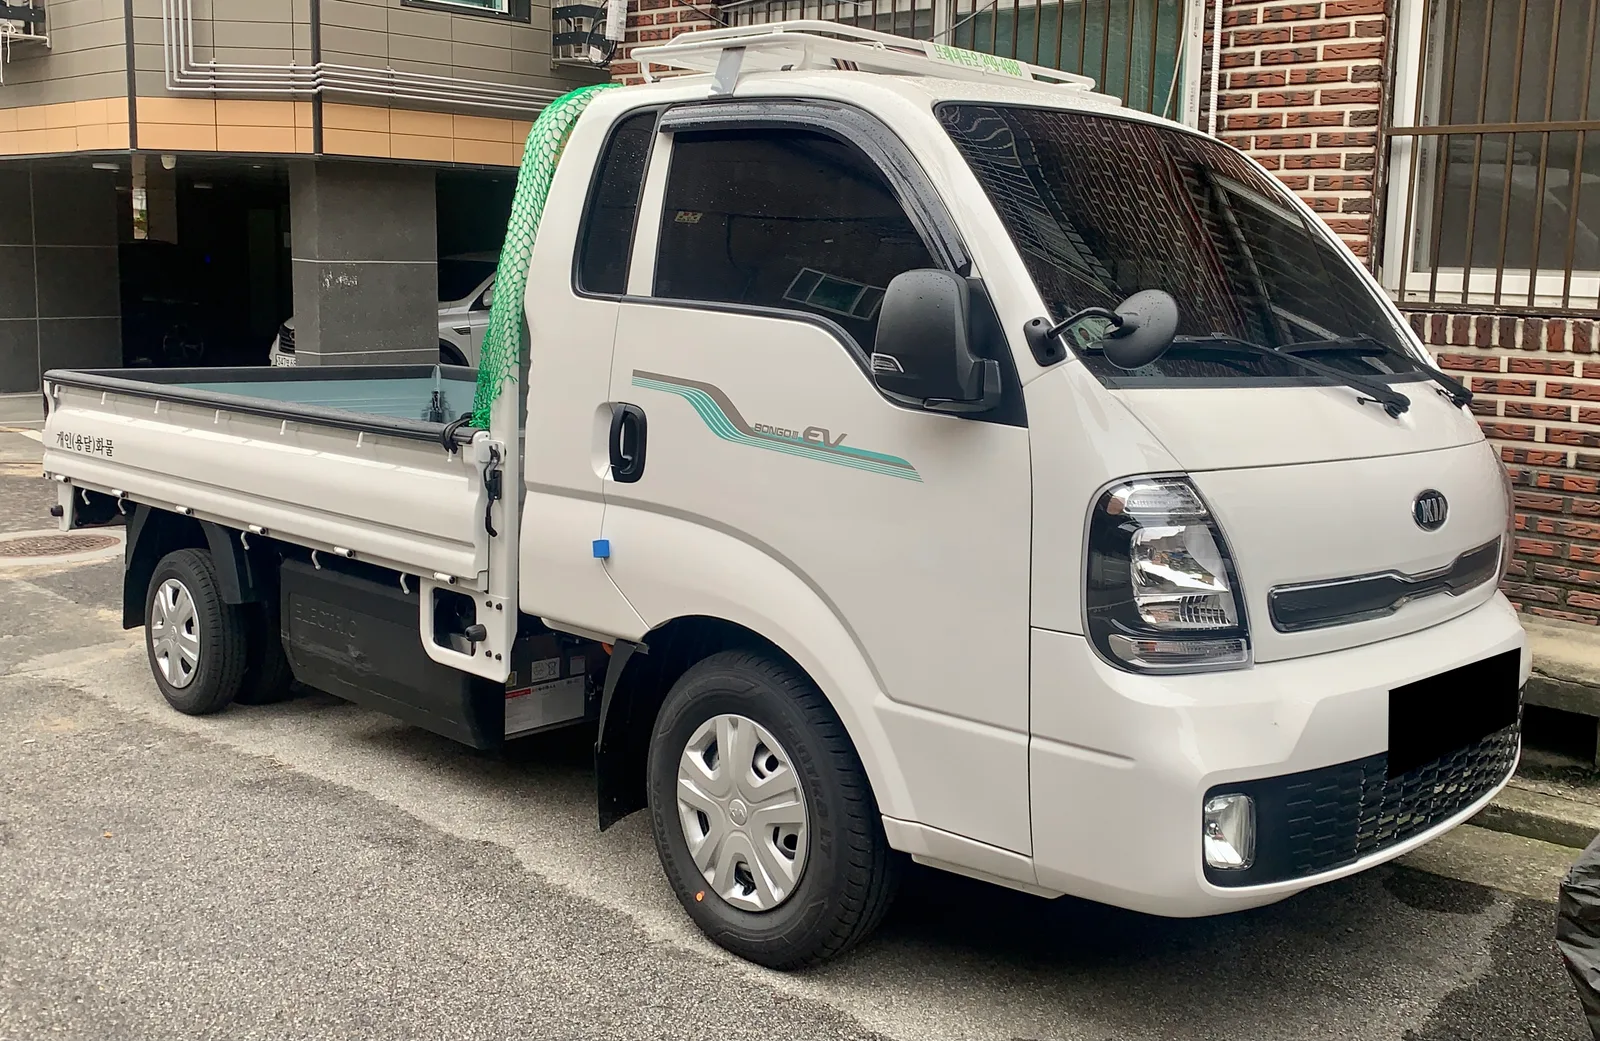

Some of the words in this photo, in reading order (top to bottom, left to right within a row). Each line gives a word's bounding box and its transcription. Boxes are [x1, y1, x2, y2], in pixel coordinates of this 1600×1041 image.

[56, 431, 114, 457] 개인(용달)화물
[754, 422, 792, 438] BONGO
[802, 425, 848, 448] EV
[1419, 496, 1447, 524] KIA
